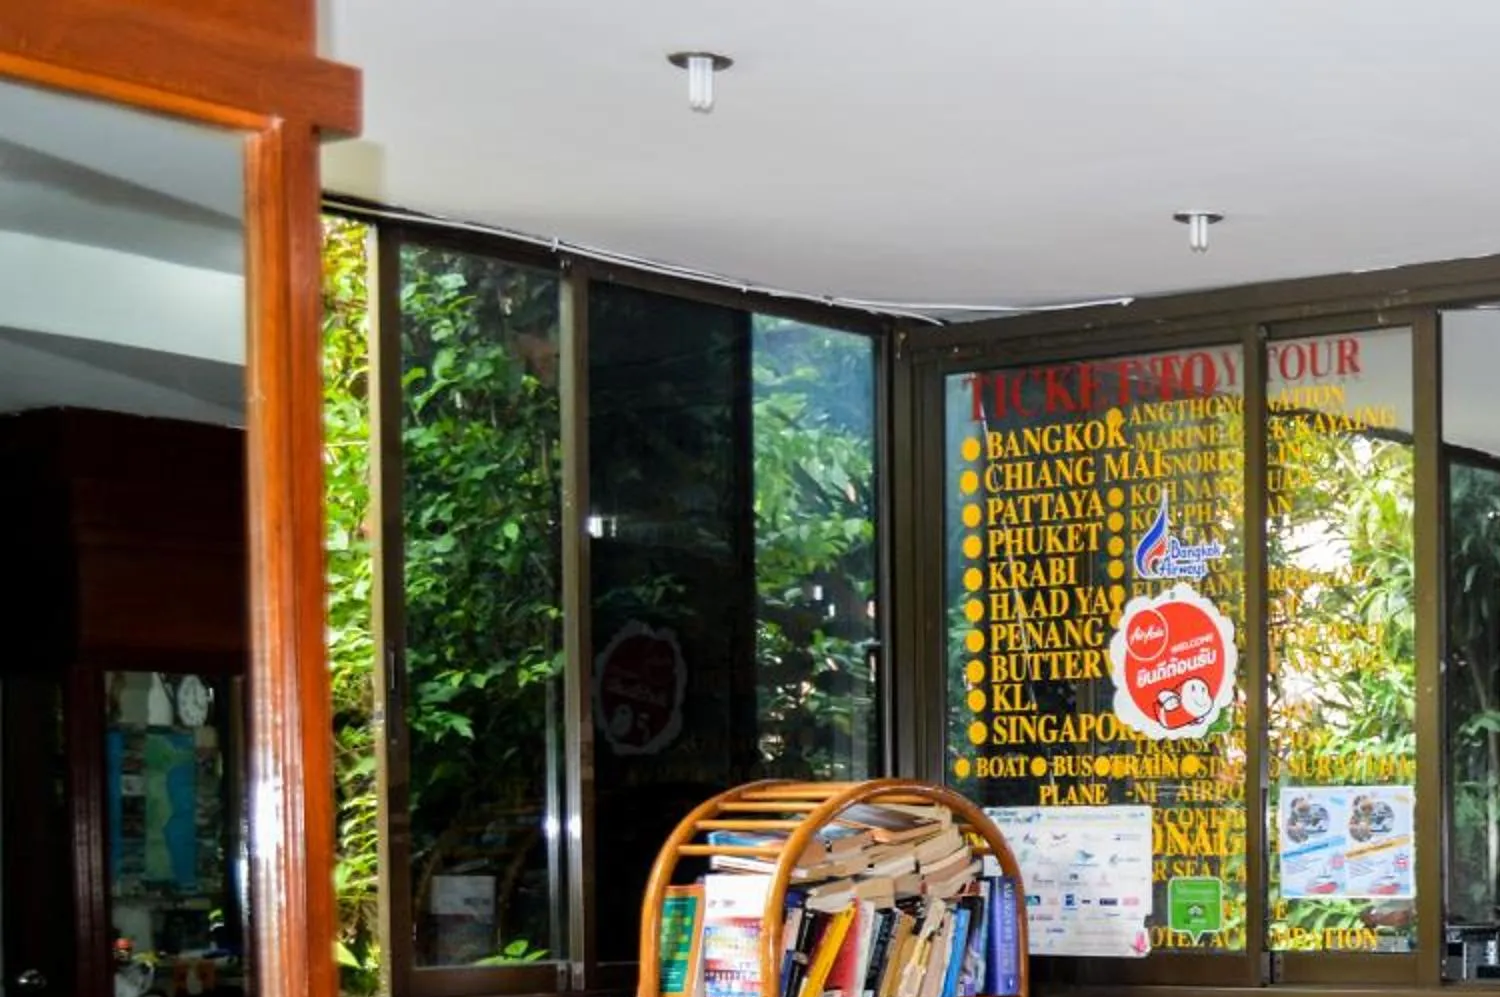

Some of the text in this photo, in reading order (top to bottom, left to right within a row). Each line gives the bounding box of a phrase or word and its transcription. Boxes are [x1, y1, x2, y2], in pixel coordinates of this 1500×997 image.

[986, 415, 1128, 461] BANGKOK
[984, 449, 1165, 493] CHIANG MAI
[987, 488, 1104, 526] PATTAYA
[987, 523, 1103, 557] PHUKET
[988, 556, 1077, 590] KRABI
[990, 588, 1069, 621] HAAD
[990, 618, 1104, 652] PENANG
[976, 756, 1029, 777] BOAT
[1053, 754, 1094, 777] BUS
[1039, 783, 1109, 806] PLANE
